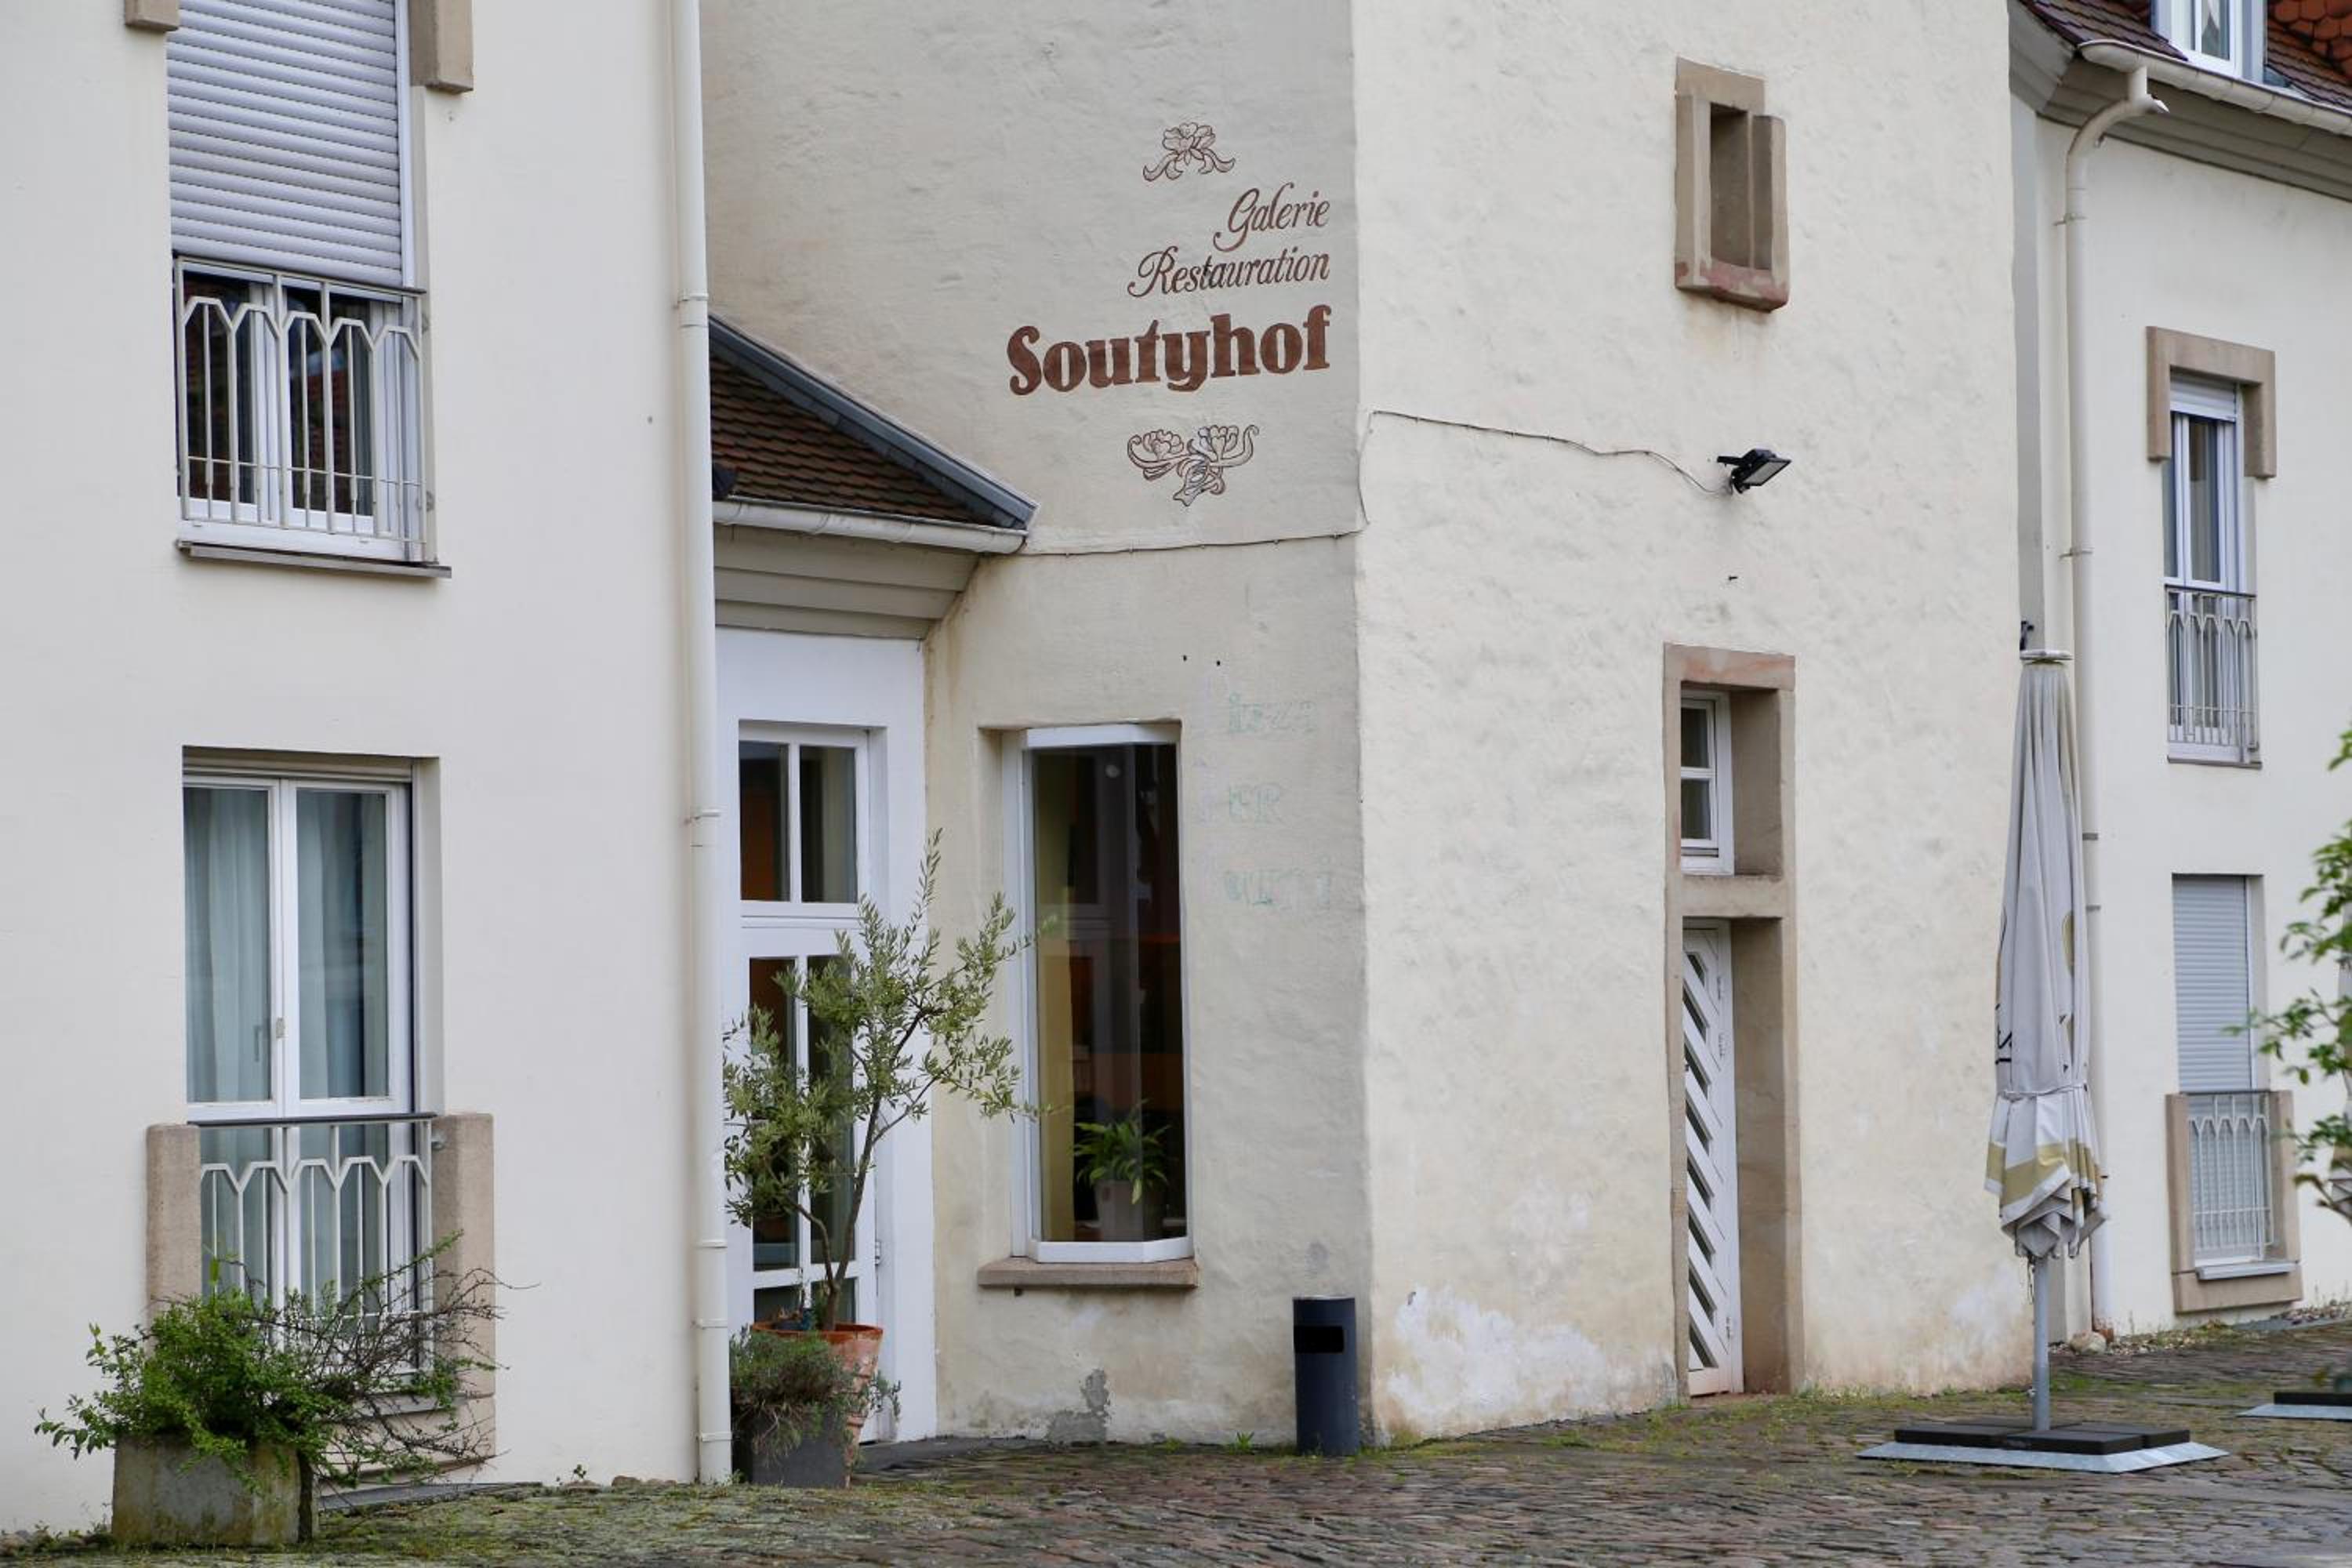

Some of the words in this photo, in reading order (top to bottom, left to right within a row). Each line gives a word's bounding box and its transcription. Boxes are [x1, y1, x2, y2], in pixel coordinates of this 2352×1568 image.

[1213, 182, 1331, 252] Galerie
[1127, 246, 1330, 298] Restauration
[1007, 304, 1332, 396] Soutyhof
